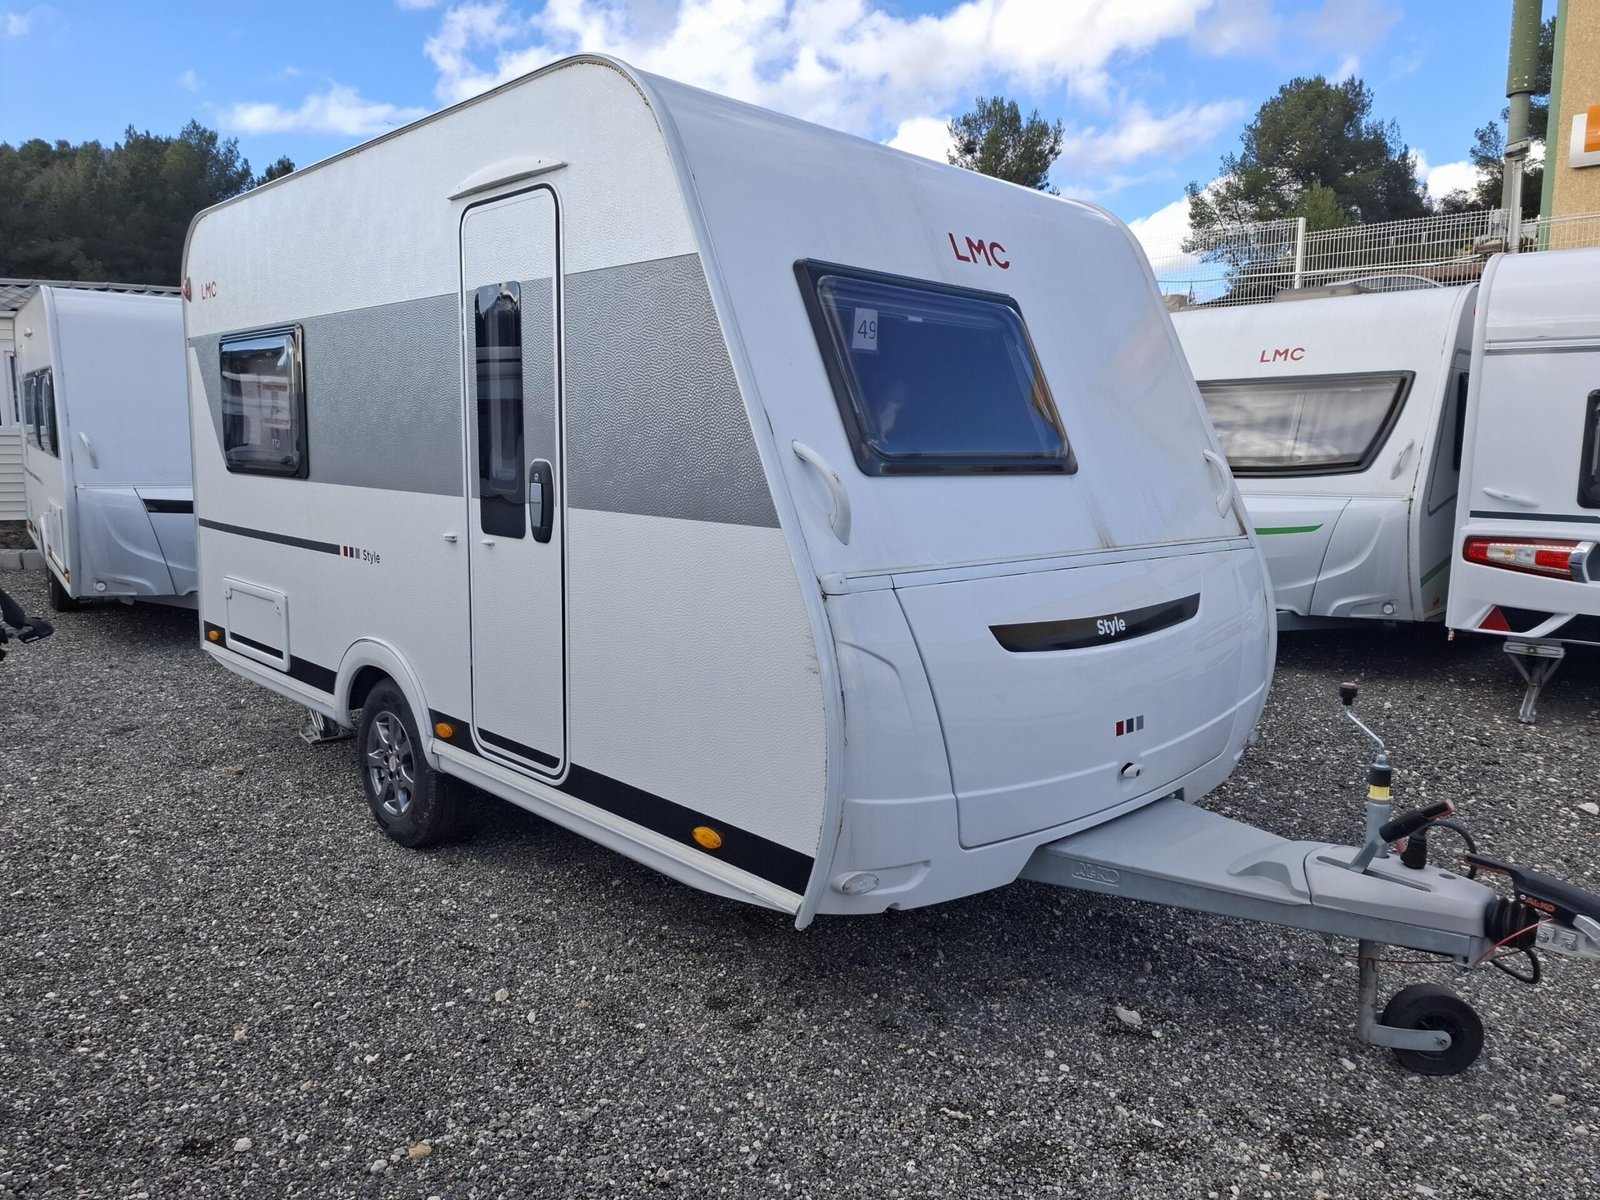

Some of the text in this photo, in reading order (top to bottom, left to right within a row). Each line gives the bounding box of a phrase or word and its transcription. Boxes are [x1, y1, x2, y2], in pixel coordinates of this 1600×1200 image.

[948, 232, 1010, 269] LMC
[201, 281, 216, 300] LMC
[857, 319, 877, 340] 49
[1260, 347, 1306, 363] LMC
[362, 549, 381, 565] Style
[1096, 615, 1126, 636] Style
